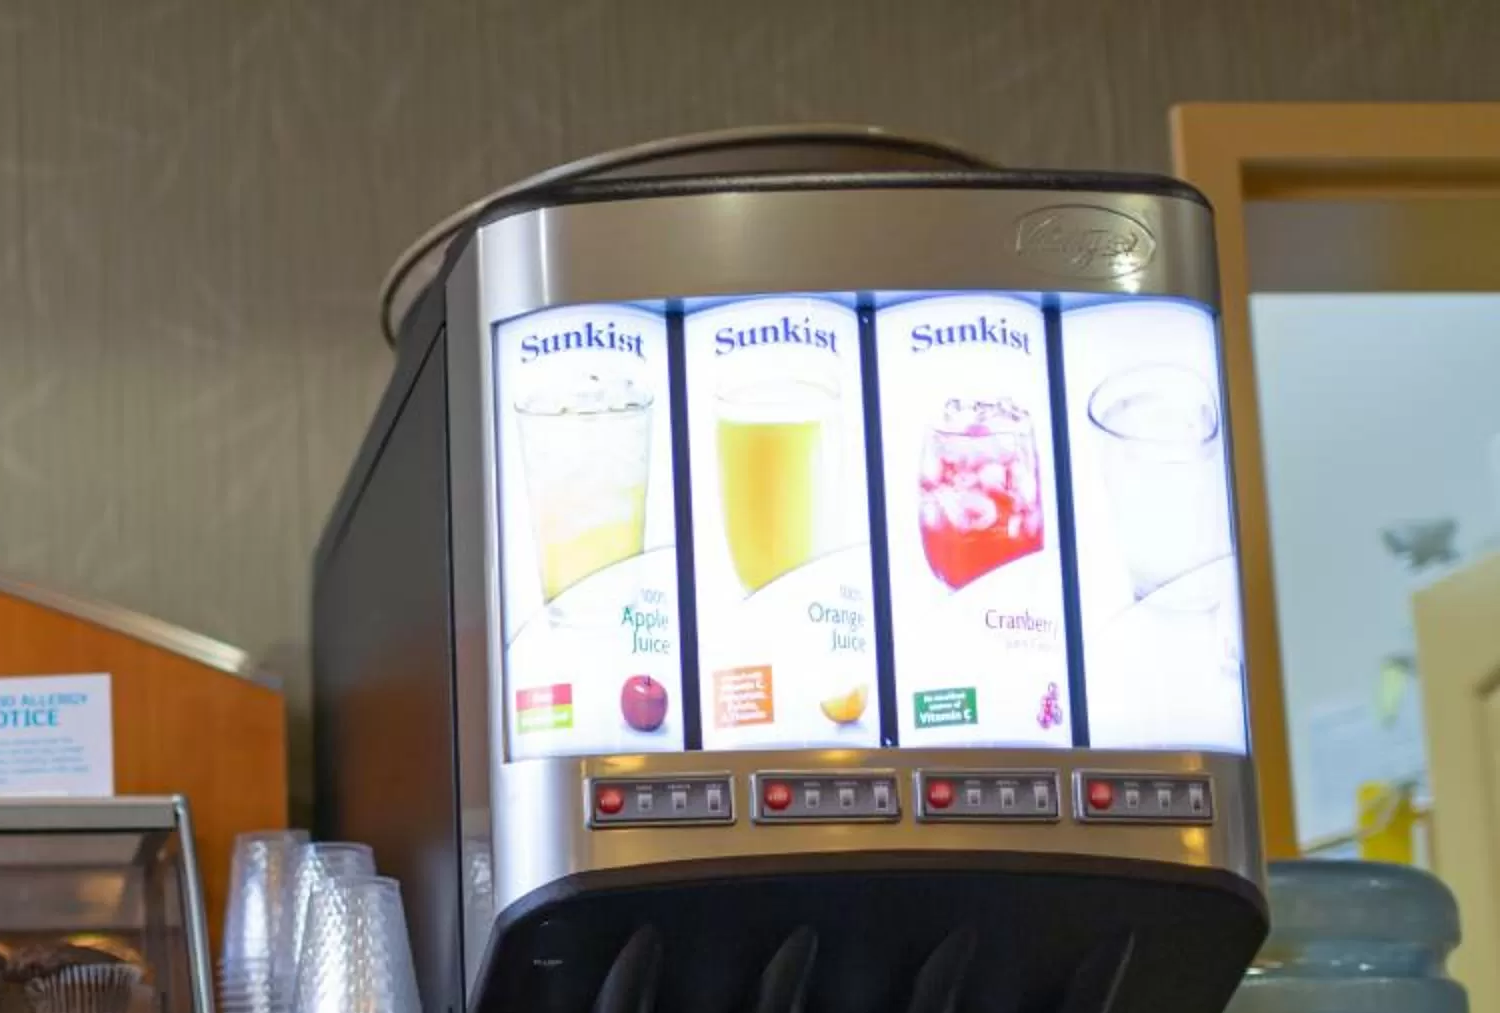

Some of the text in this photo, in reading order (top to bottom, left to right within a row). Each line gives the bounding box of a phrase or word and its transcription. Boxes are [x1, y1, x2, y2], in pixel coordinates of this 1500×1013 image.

[521, 322, 646, 363] Sunkist
[715, 317, 840, 356] Sunkist
[911, 316, 1031, 355] Sunkist
[620, 605, 669, 633] Apple
[807, 601, 865, 631] Orange
[632, 631, 671, 654] Juice
[831, 629, 866, 652] Juice
[964, 708, 973, 720] C
